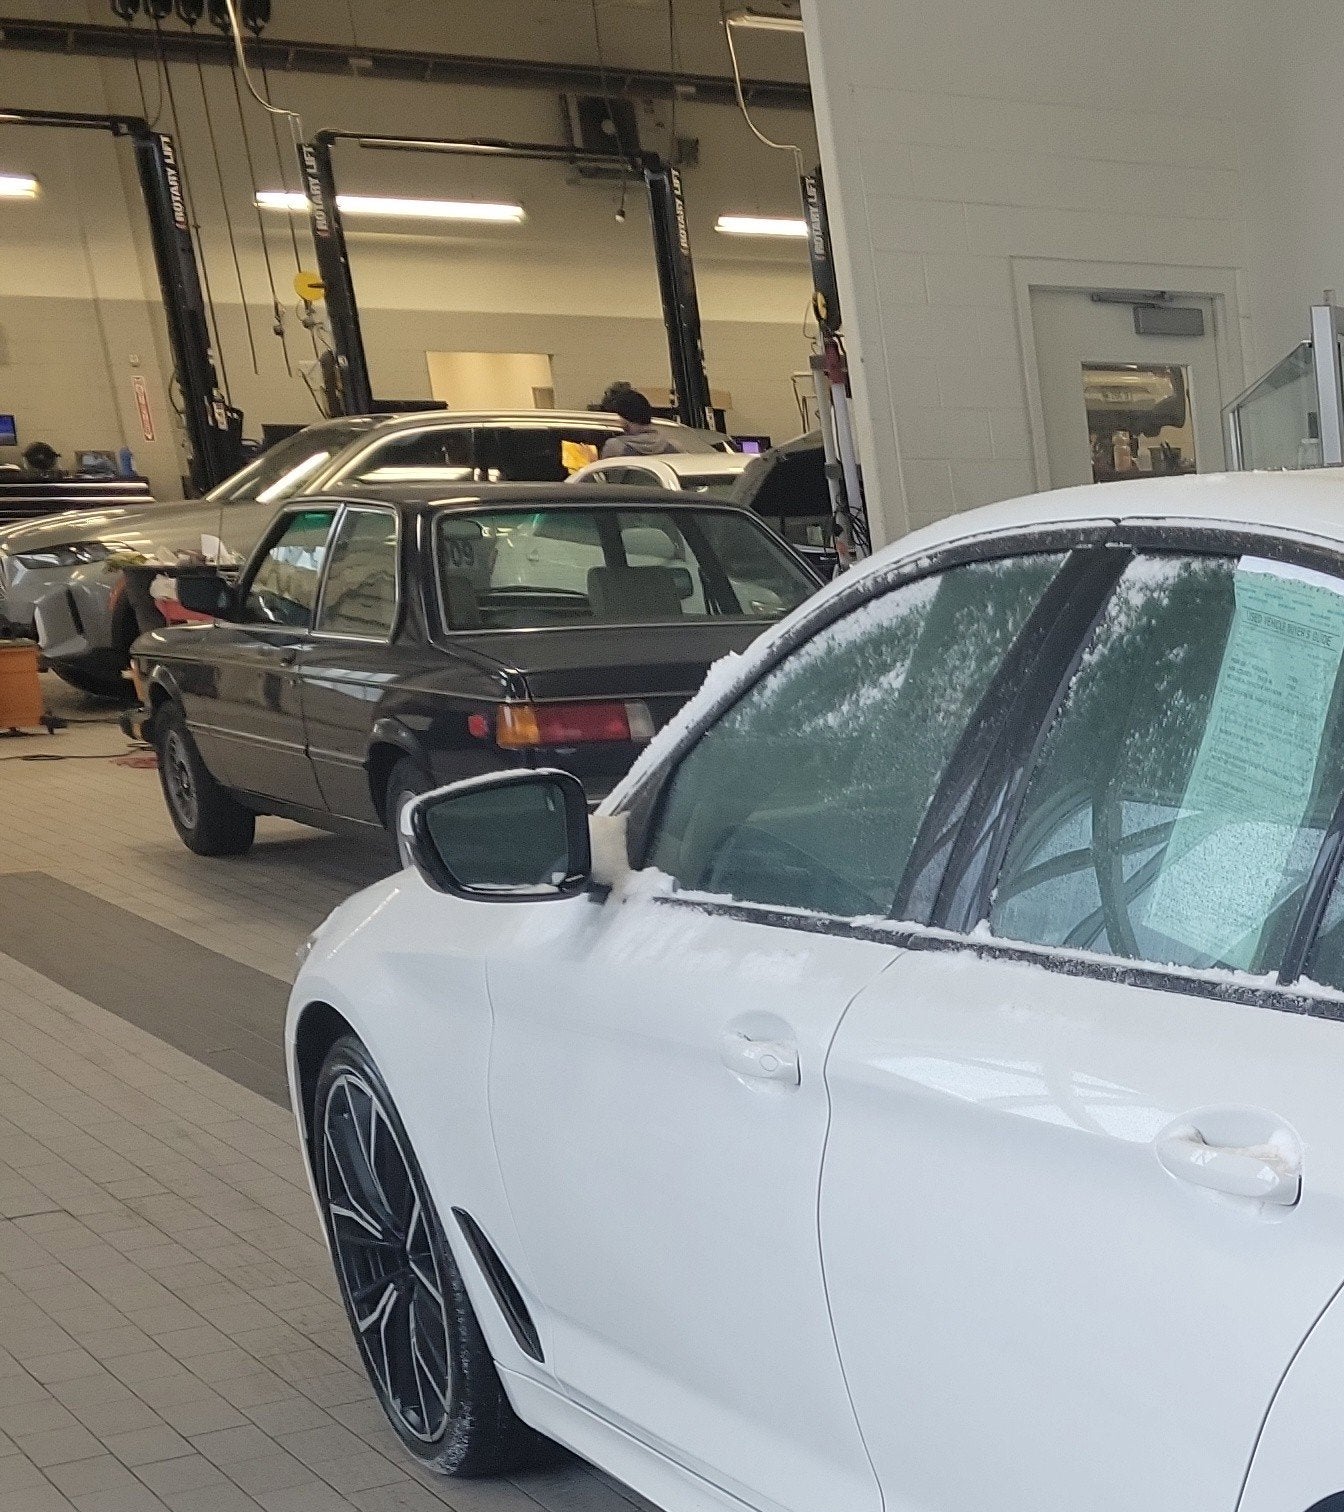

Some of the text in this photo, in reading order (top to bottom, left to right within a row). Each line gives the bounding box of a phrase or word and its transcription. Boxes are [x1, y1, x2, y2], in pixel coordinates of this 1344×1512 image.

[160, 135, 177, 165] LIFT
[303, 144, 318, 173] LIFT
[671, 168, 683, 196] LIFT
